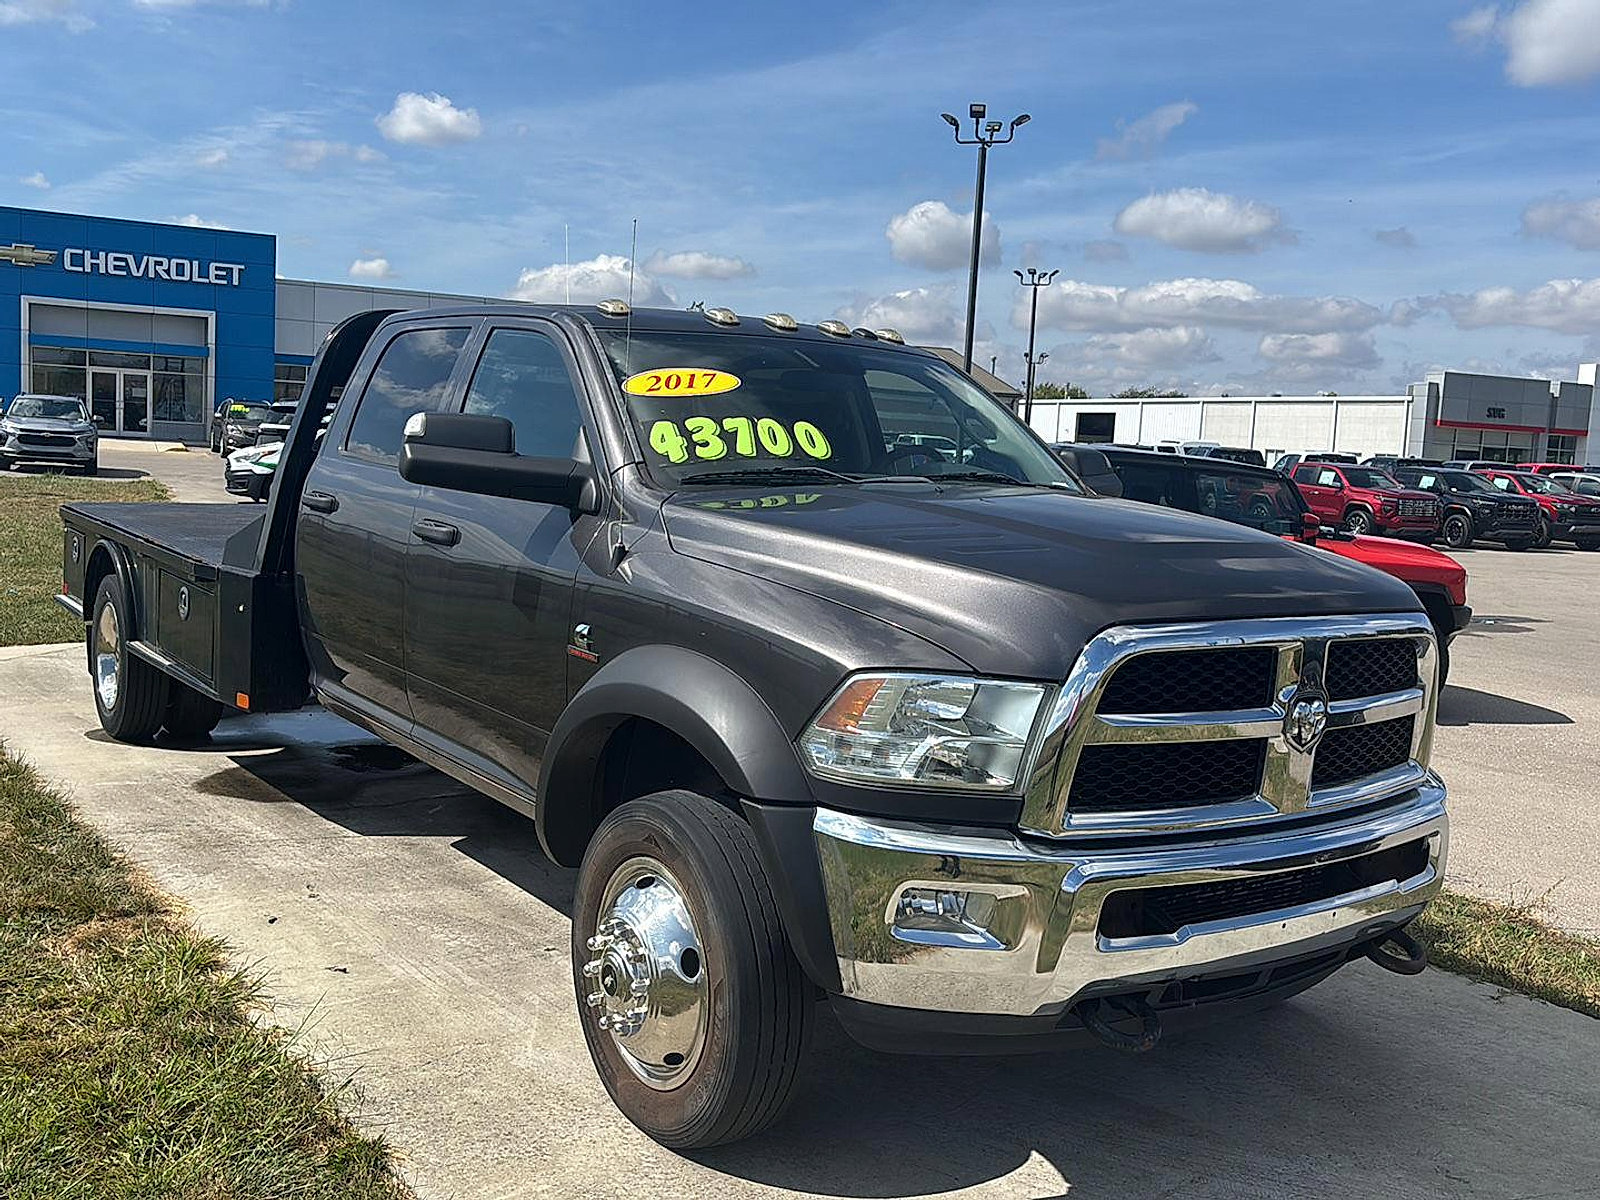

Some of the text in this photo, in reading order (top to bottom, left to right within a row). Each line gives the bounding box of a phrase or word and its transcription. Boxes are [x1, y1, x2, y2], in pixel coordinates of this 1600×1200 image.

[64, 248, 245, 286] CHEVROLET
[646, 373, 717, 392] 2017
[649, 416, 832, 464] 43700
